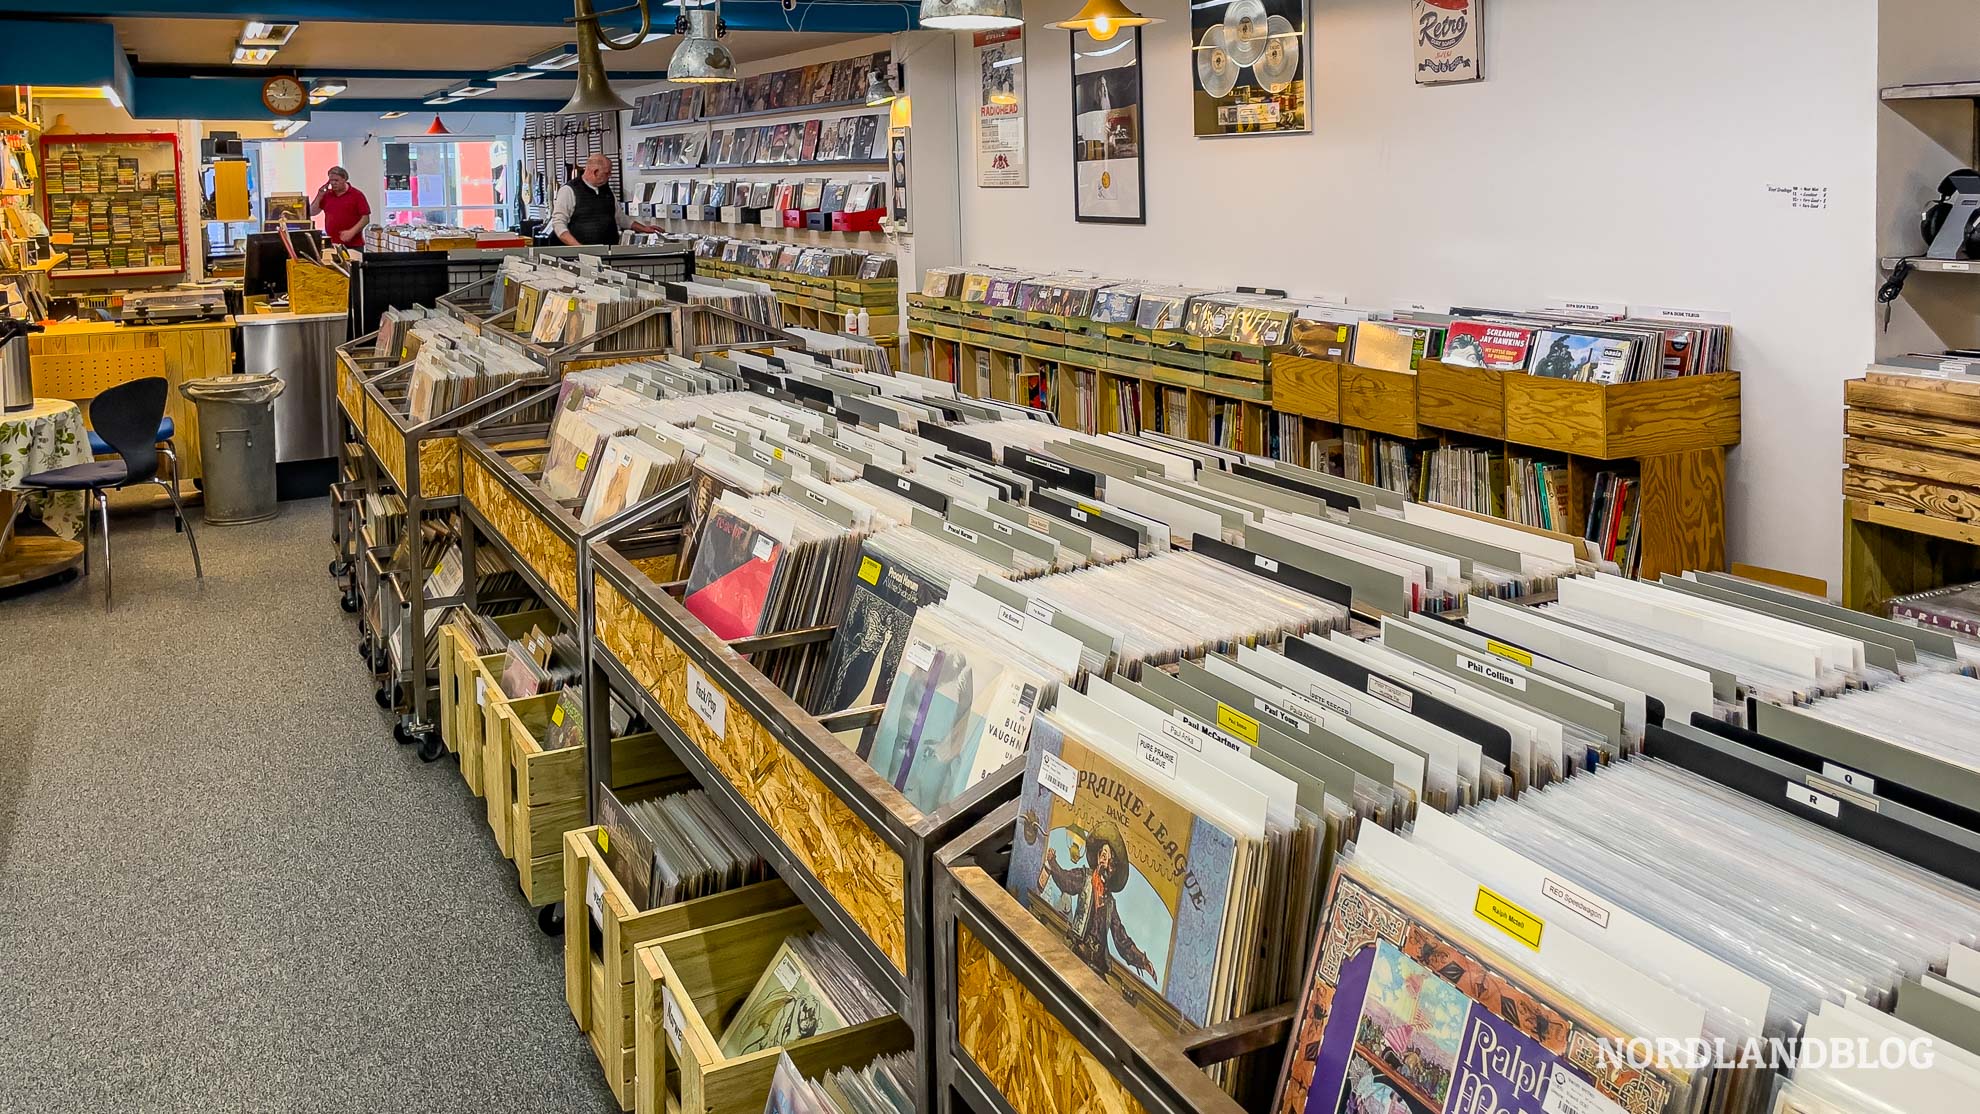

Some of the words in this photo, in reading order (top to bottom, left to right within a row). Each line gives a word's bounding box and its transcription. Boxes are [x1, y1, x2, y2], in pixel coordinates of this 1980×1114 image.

[1419, 11, 1466, 47] Retro
[980, 103, 1018, 117] RADIOHEAD
[1480, 335, 1493, 343] JAY
[1493, 336, 1525, 348] HAWKINS
[1486, 328, 1522, 339] SCREAMIN'
[1604, 349, 1622, 357] oasis
[1467, 660, 1483, 674] Phil
[1485, 667, 1514, 685] Collins
[1004, 717, 1027, 736] BILLY
[1264, 703, 1278, 717] Paul
[1280, 711, 1299, 729] Young
[988, 723, 1022, 750] VAUGHN
[1169, 725, 1181, 737] Paul
[1180, 731, 1194, 745] Anka
[1182, 716, 1200, 731] Paul
[1201, 725, 1240, 752] McCartney
[1140, 739, 1153, 753] PURE
[1153, 745, 1175, 764] PRAIRIE
[1145, 752, 1166, 769] LEAGUE
[1844, 774, 1853, 785] Q
[1077, 769, 1144, 818] PRAIRIE
[1809, 793, 1818, 805] R
[1106, 804, 1130, 828] DANCE
[1142, 810, 1208, 911] LEAGUE
[1492, 905, 1508, 920] Ralph
[1549, 885, 1564, 899] REO
[1564, 893, 1602, 920] Speedwagon
[1463, 1016, 1552, 1101] Ralph
